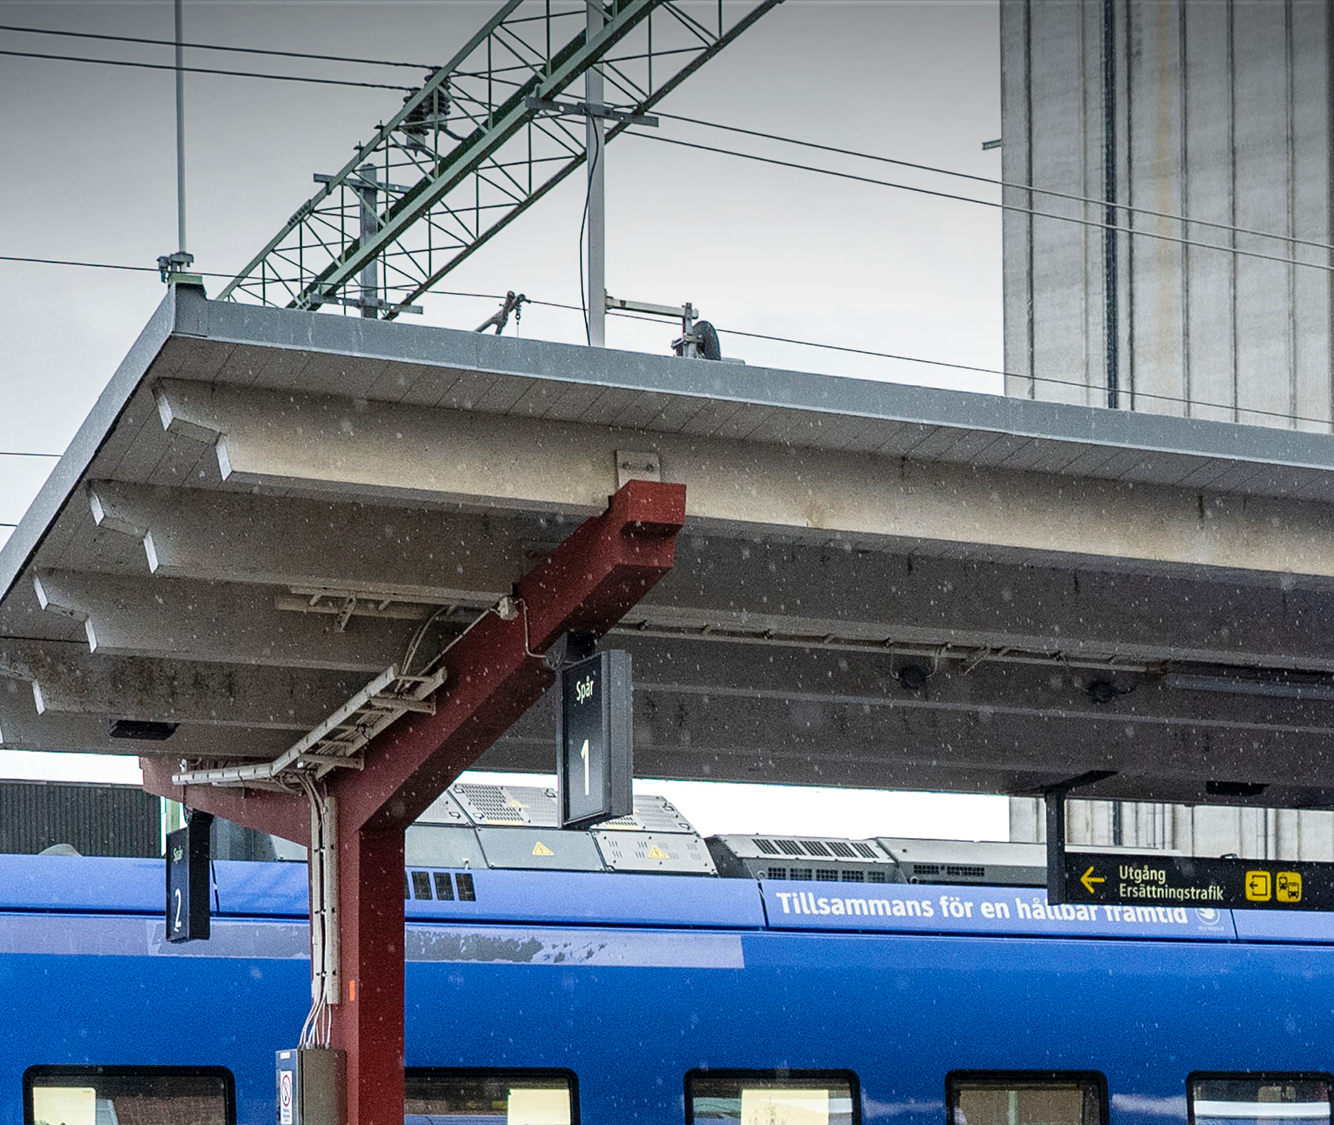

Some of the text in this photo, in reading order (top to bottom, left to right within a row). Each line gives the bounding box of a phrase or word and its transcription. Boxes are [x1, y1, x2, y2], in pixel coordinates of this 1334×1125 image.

[575, 675, 595, 704] Spår
[580, 739, 590, 796] 1
[1119, 864, 1166, 885] Utgång
[775, 892, 935, 917] Tillsammans
[939, 895, 974, 919] för
[980, 902, 1011, 919] en
[1119, 883, 1224, 902] Ersättningstrafik
[174, 888, 182, 933] 2
